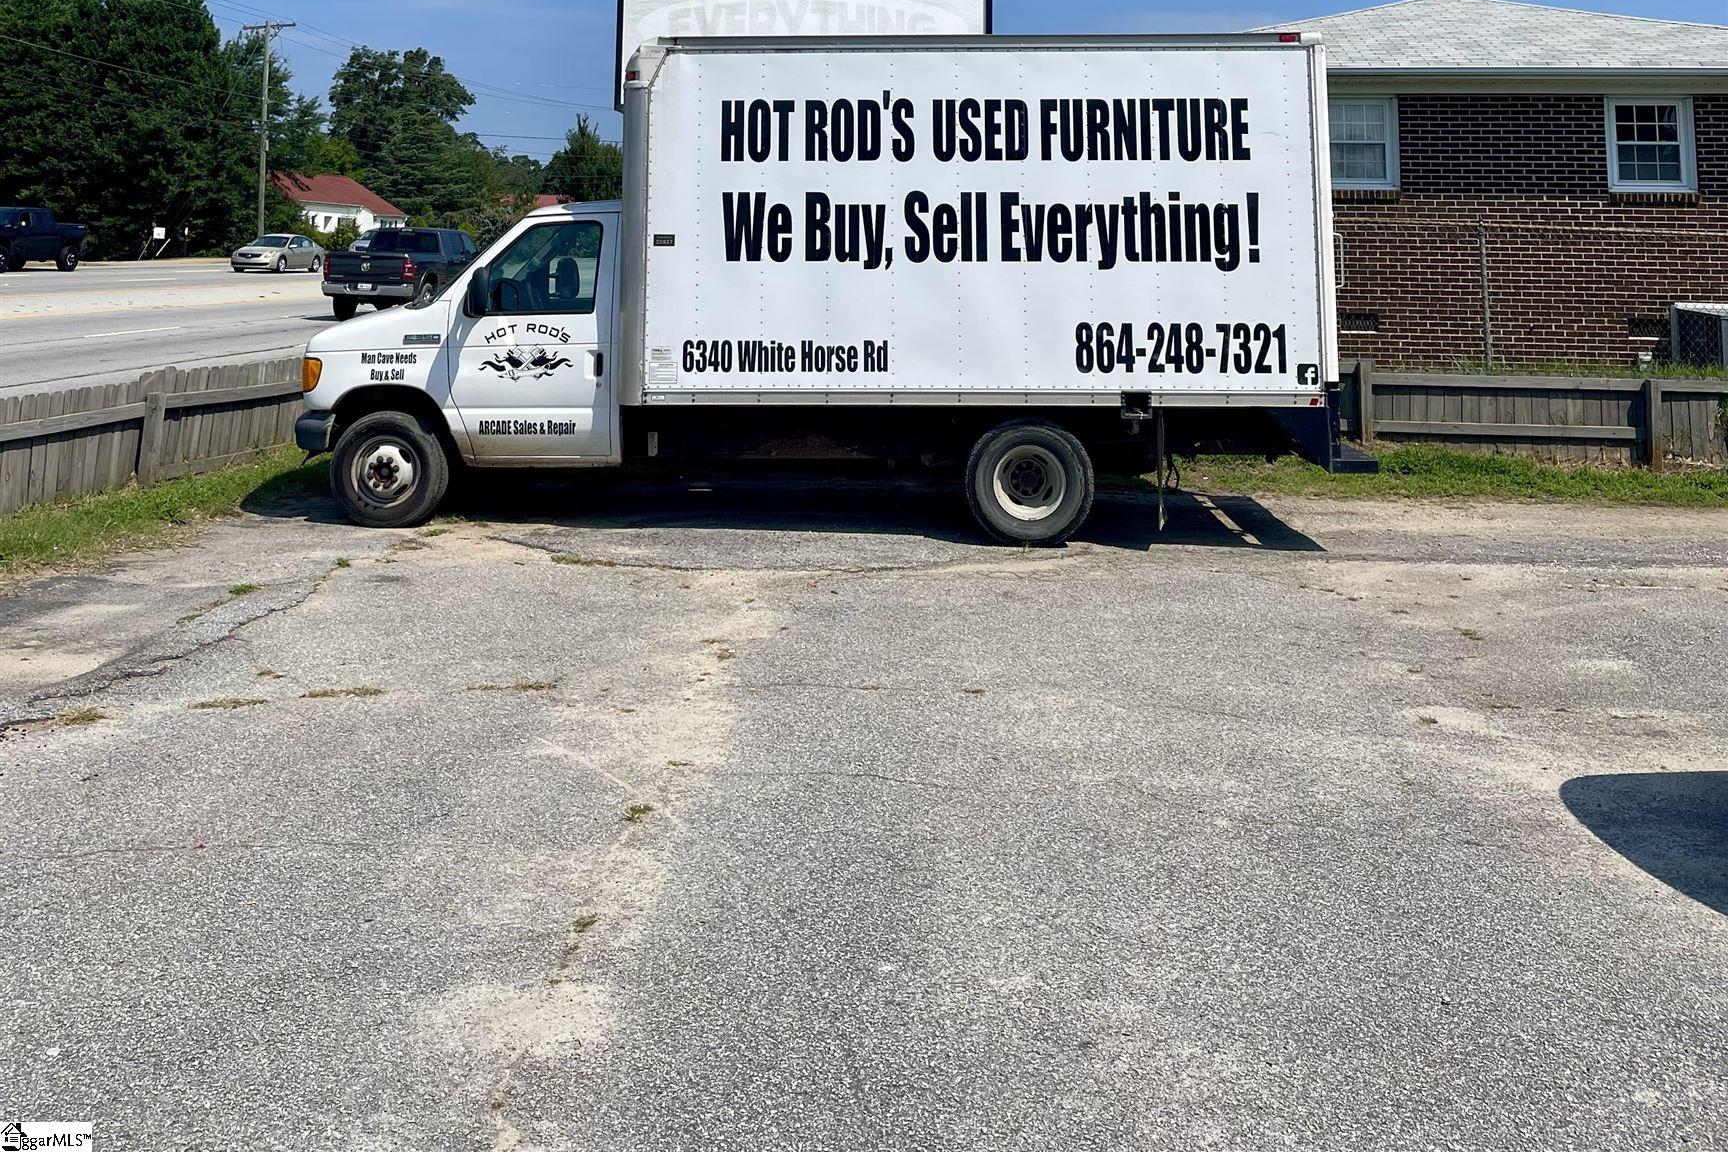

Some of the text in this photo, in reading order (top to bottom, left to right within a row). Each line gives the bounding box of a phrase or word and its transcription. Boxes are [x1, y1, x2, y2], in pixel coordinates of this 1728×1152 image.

[721, 90, 1251, 162] HOT ROD'S USED FURNITURE
[723, 192, 793, 263] We
[806, 193, 893, 271] Buy,
[905, 191, 988, 264] Sell
[485, 323, 571, 344] HOT ROD'S
[361, 352, 417, 364] Man Cave Needs
[682, 340, 733, 373] 6340
[738, 341, 796, 373] White
[802, 341, 859, 373] Horse
[864, 341, 889, 373] Rd
[1075, 322, 1287, 375] 864-248-7321
[370, 368, 404, 381] Buy & Sell
[479, 420, 576, 437] ARCADE Sales & Repair
